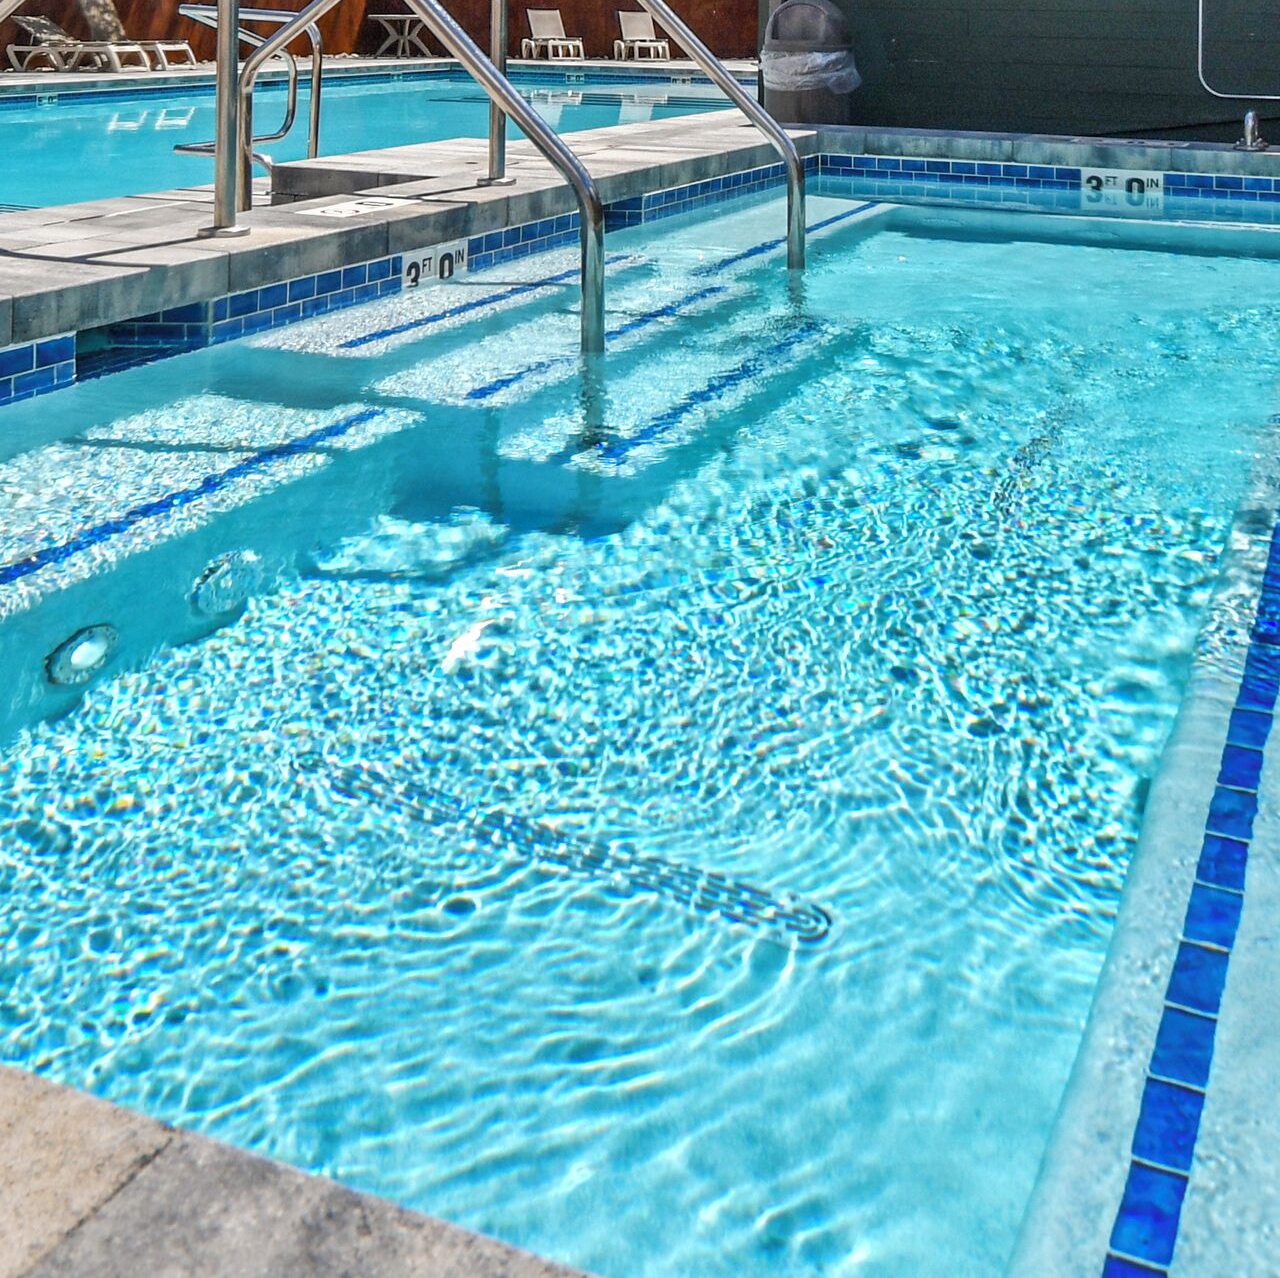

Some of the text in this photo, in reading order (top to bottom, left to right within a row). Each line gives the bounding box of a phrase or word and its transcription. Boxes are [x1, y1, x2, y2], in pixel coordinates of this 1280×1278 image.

[1086, 176, 1159, 206] 3 FT 0 IN
[422, 257, 432, 273] FT
[439, 252, 454, 279] 0
[455, 249, 464, 265] IN
